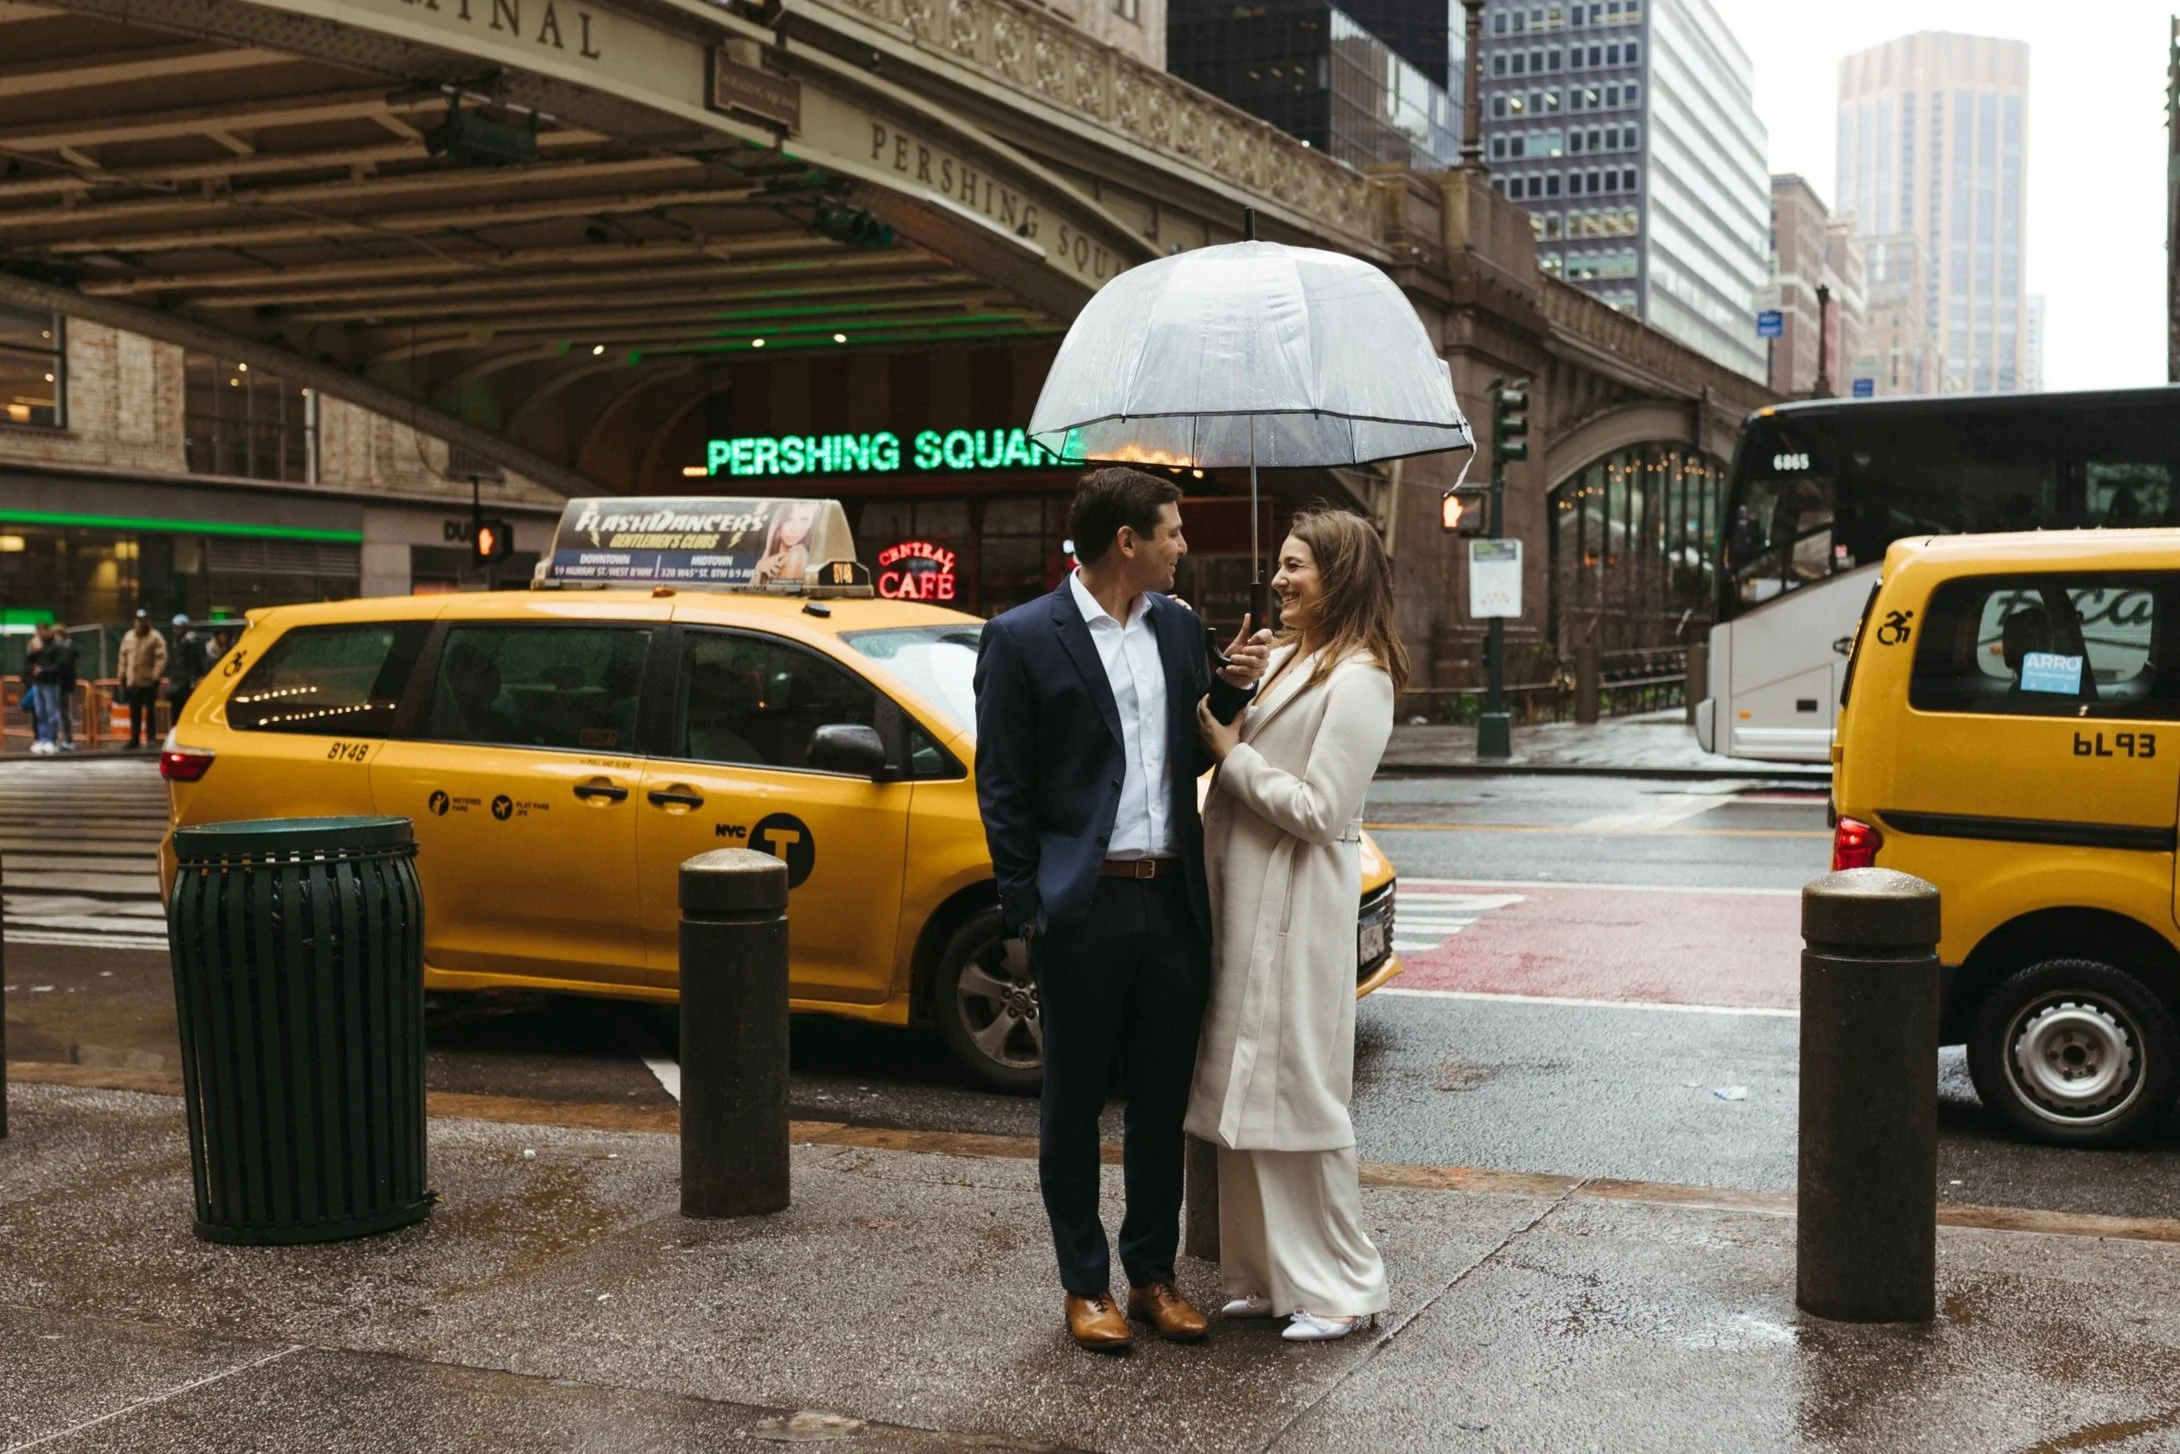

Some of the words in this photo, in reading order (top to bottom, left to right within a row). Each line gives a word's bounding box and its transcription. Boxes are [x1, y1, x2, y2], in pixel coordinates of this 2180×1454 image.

[870, 122, 1039, 239] PERSHING
[1057, 224, 1124, 280] SQU
[707, 432, 900, 476] PERSHING
[1773, 453, 1810, 471] 6865
[680, 534, 721, 549] CLUBS
[579, 553, 631, 565] DOWNTOWN
[690, 555, 734, 566] MIDTOWN
[878, 541, 956, 568] CENTRAL
[2026, 654, 2081, 672] ARRO
[715, 823, 747, 838] NYC
